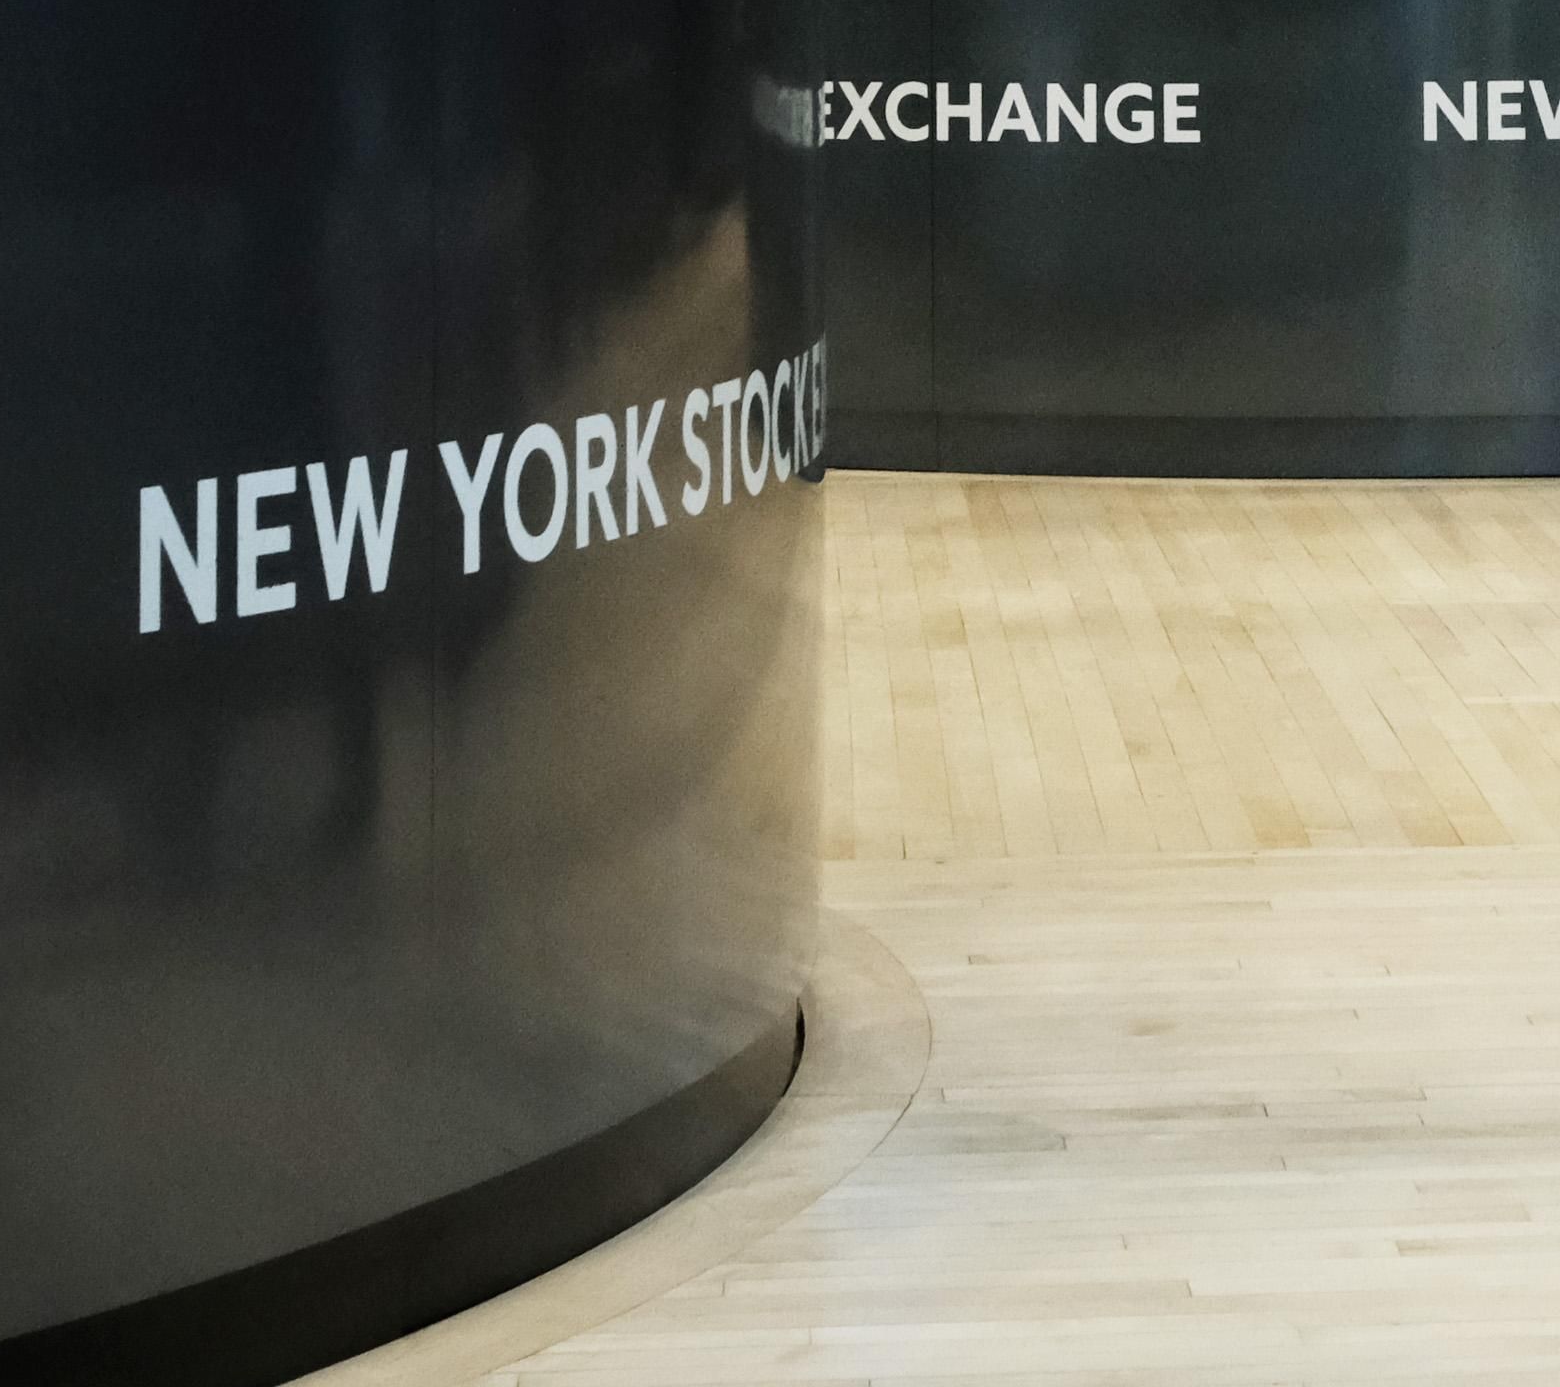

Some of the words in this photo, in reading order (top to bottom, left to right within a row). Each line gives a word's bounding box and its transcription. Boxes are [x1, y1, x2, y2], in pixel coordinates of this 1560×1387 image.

[138, 447, 409, 636] NEW
[439, 396, 668, 576] YORK
[681, 354, 813, 517] STOCK
